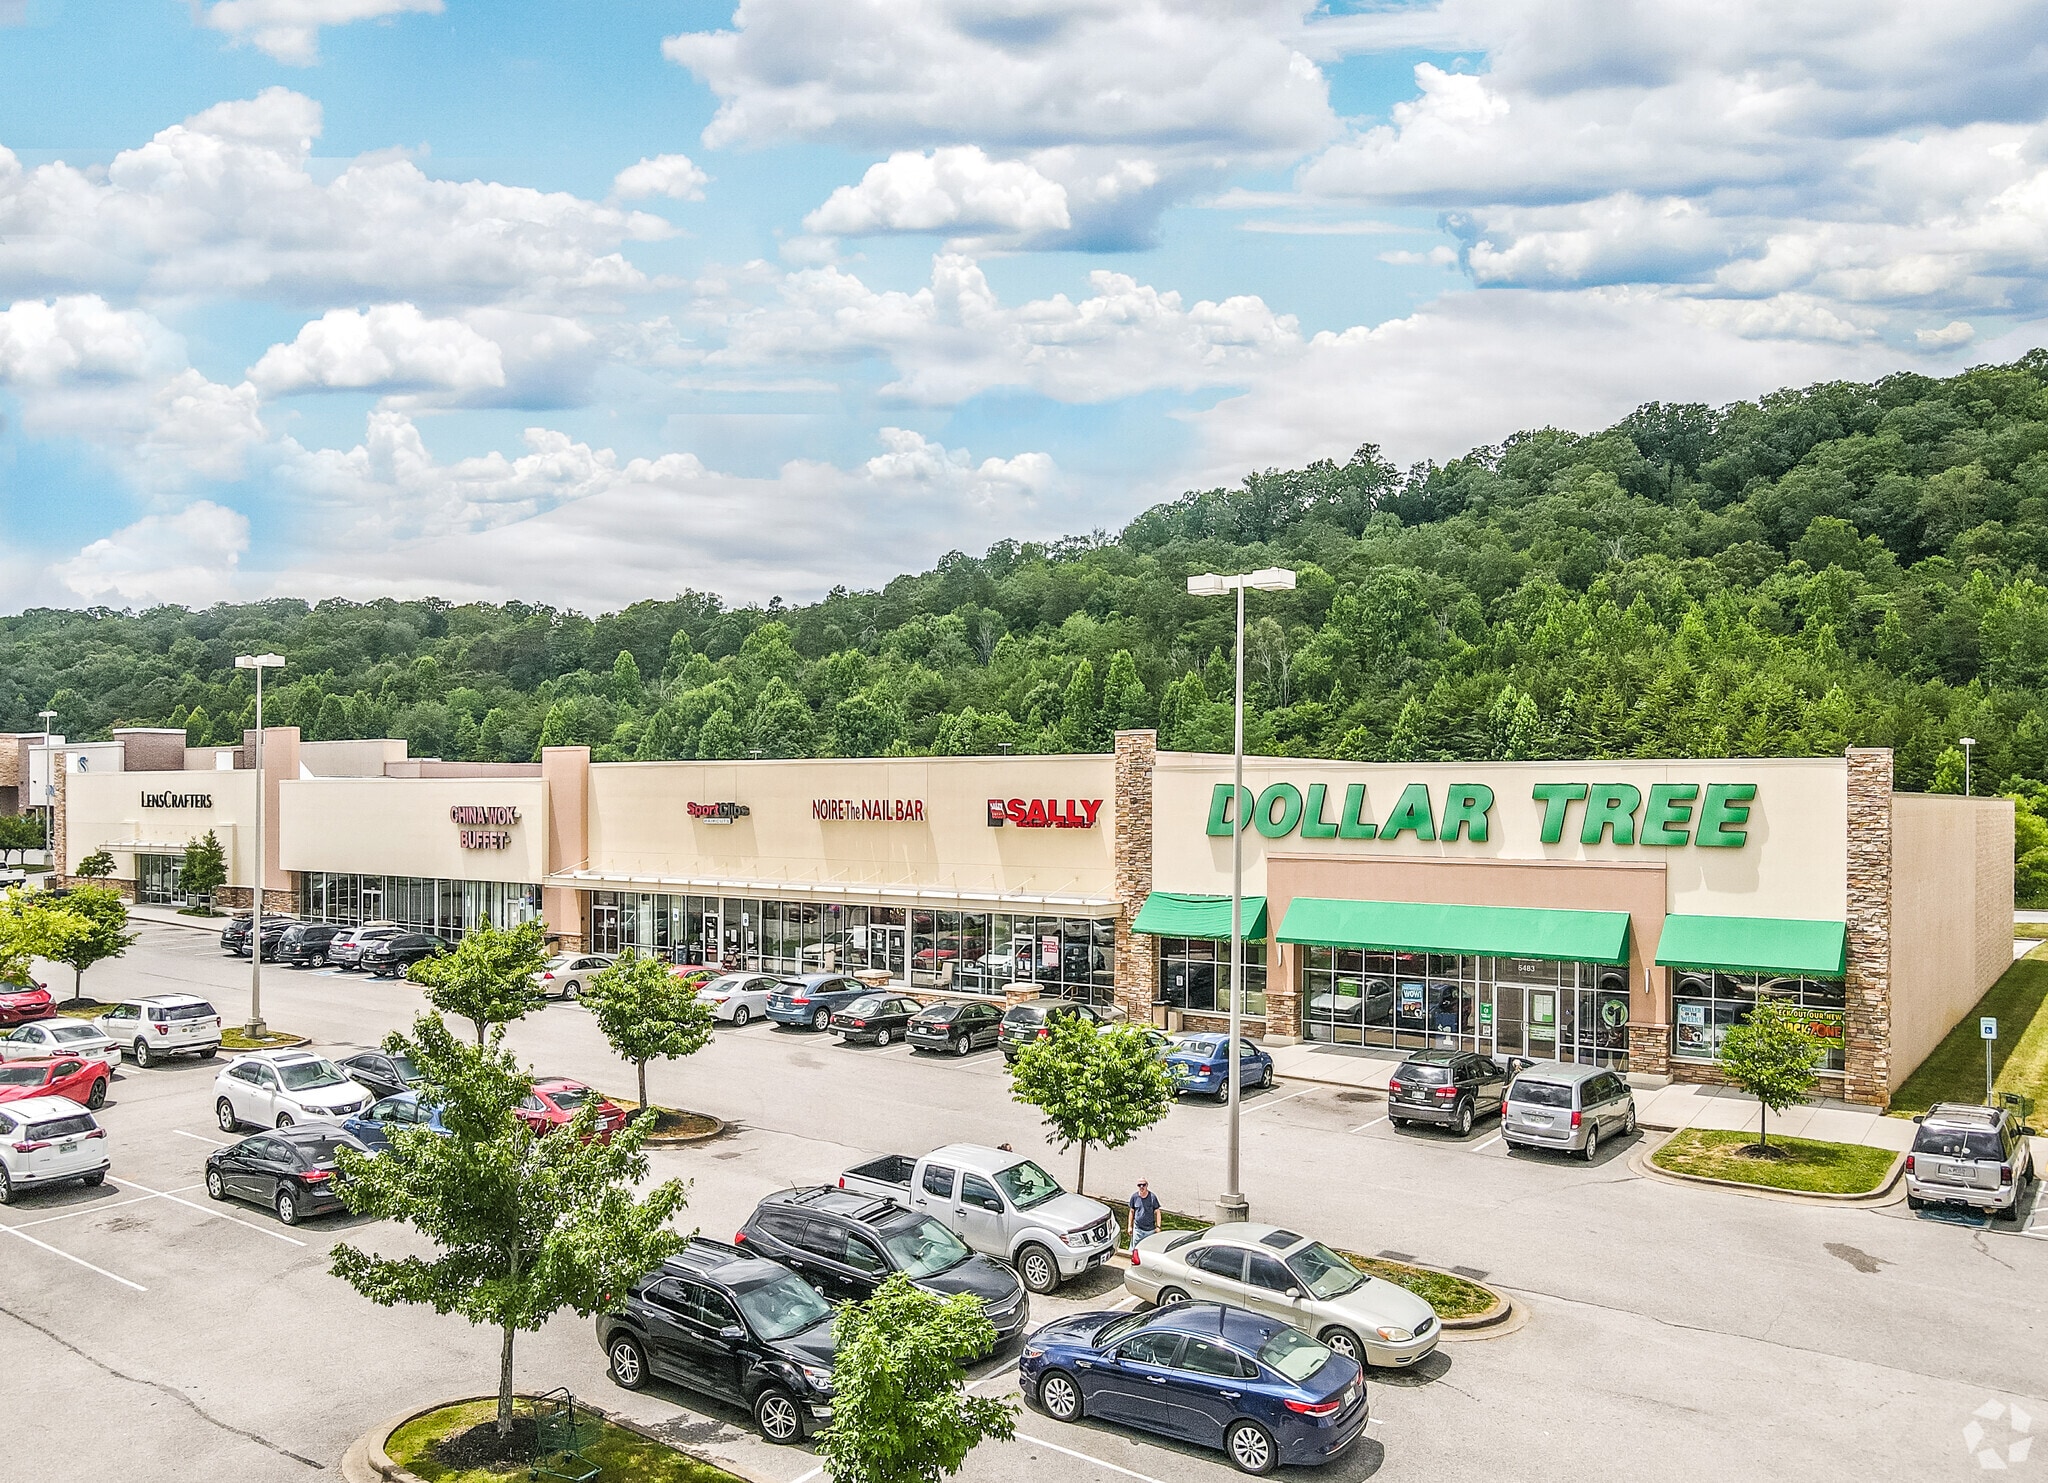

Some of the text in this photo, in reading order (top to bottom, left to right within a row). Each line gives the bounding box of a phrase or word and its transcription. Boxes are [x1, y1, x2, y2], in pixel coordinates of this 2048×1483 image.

[449, 805, 516, 826] CHINA WOK
[812, 799, 924, 821] NOIRE The NAIL BAR
[1006, 798, 1103, 823] SALLY
[1206, 783, 1757, 847] DOLLAR TREE
[460, 830, 507, 849] BUFFET
[1517, 963, 1536, 973] 5483
[1793, 1010, 1807, 1018] OUT
[1809, 1011, 1824, 1020] OUR
[1826, 1012, 1843, 1021] NEW
[1809, 1021, 1843, 1038] ZONE
